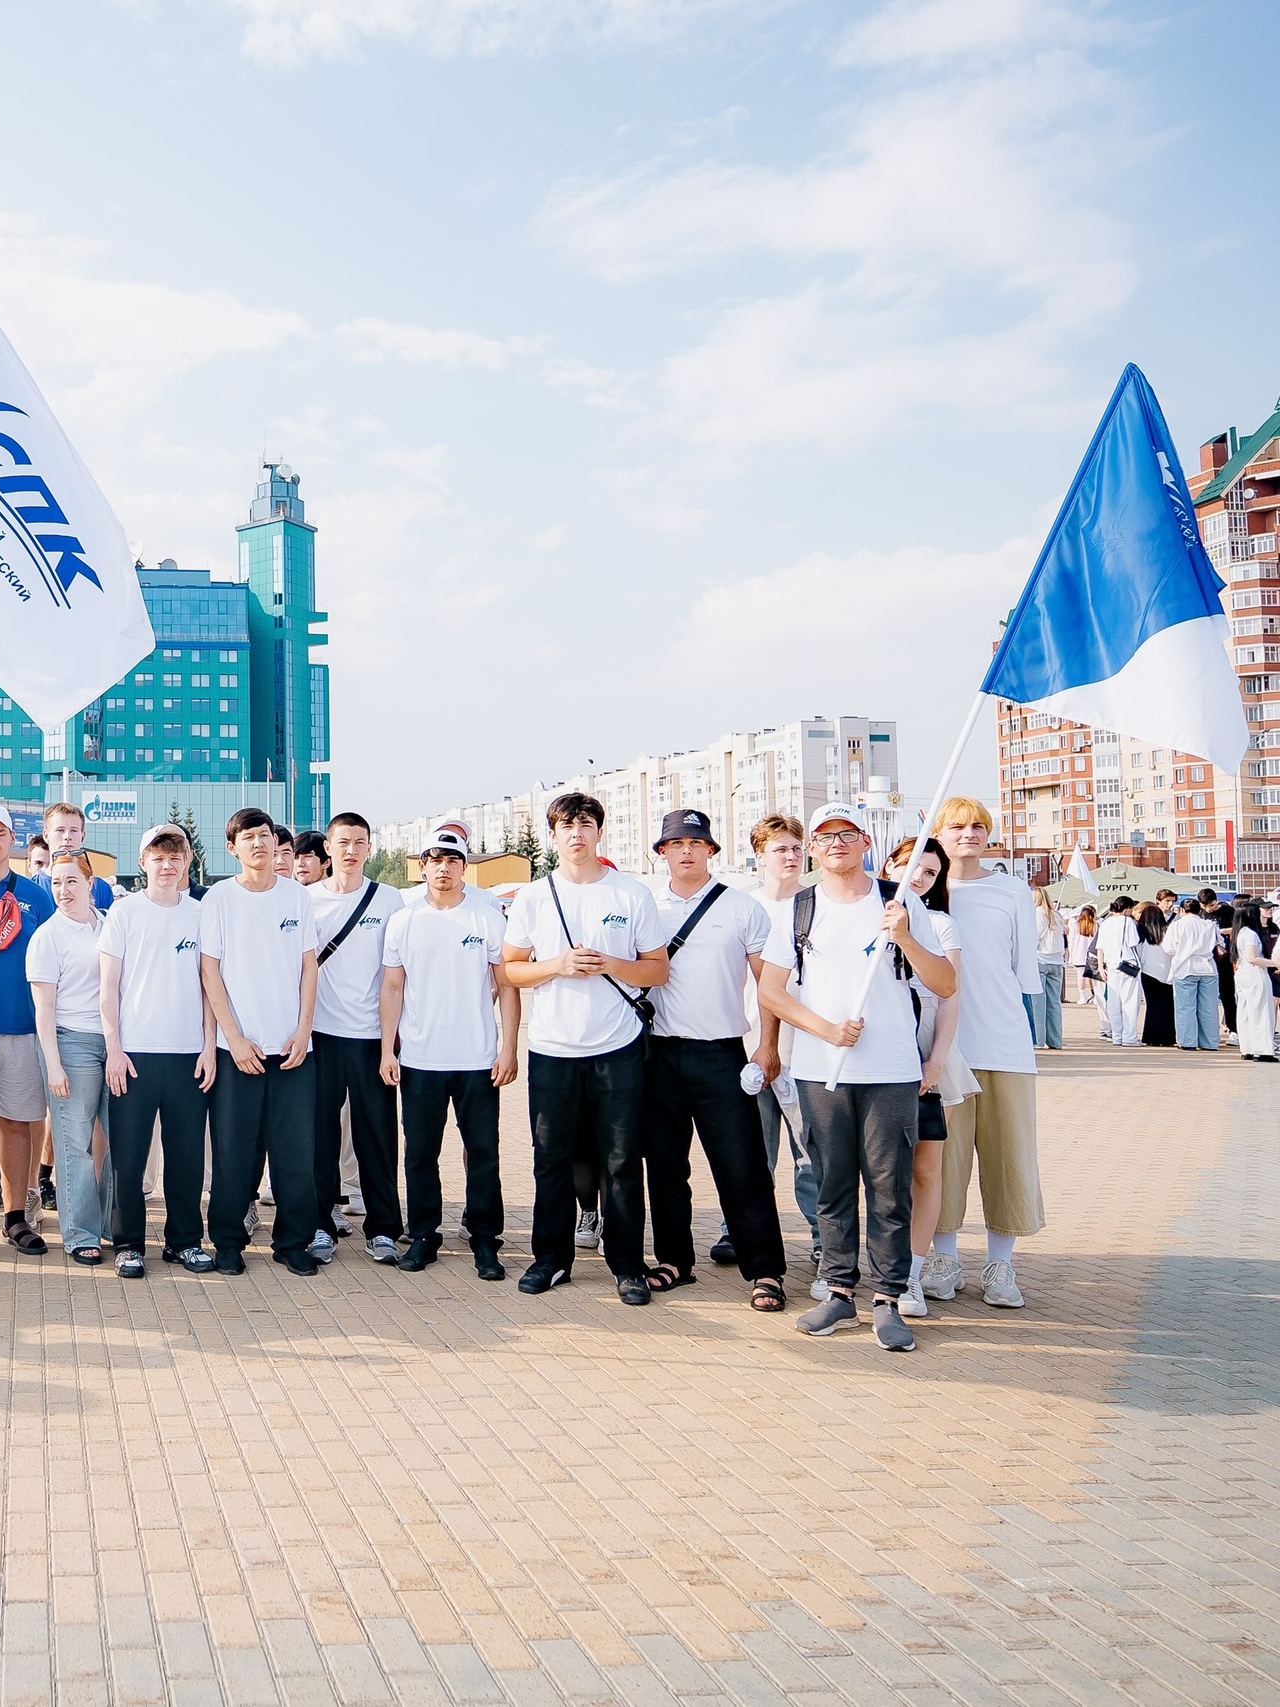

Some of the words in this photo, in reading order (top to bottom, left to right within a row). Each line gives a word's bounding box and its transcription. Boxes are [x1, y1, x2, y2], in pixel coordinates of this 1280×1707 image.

[101, 802, 136, 811] ГАЗПРОМ
[18, 901, 31, 911] ПК
[610, 915, 628, 923] СПК
